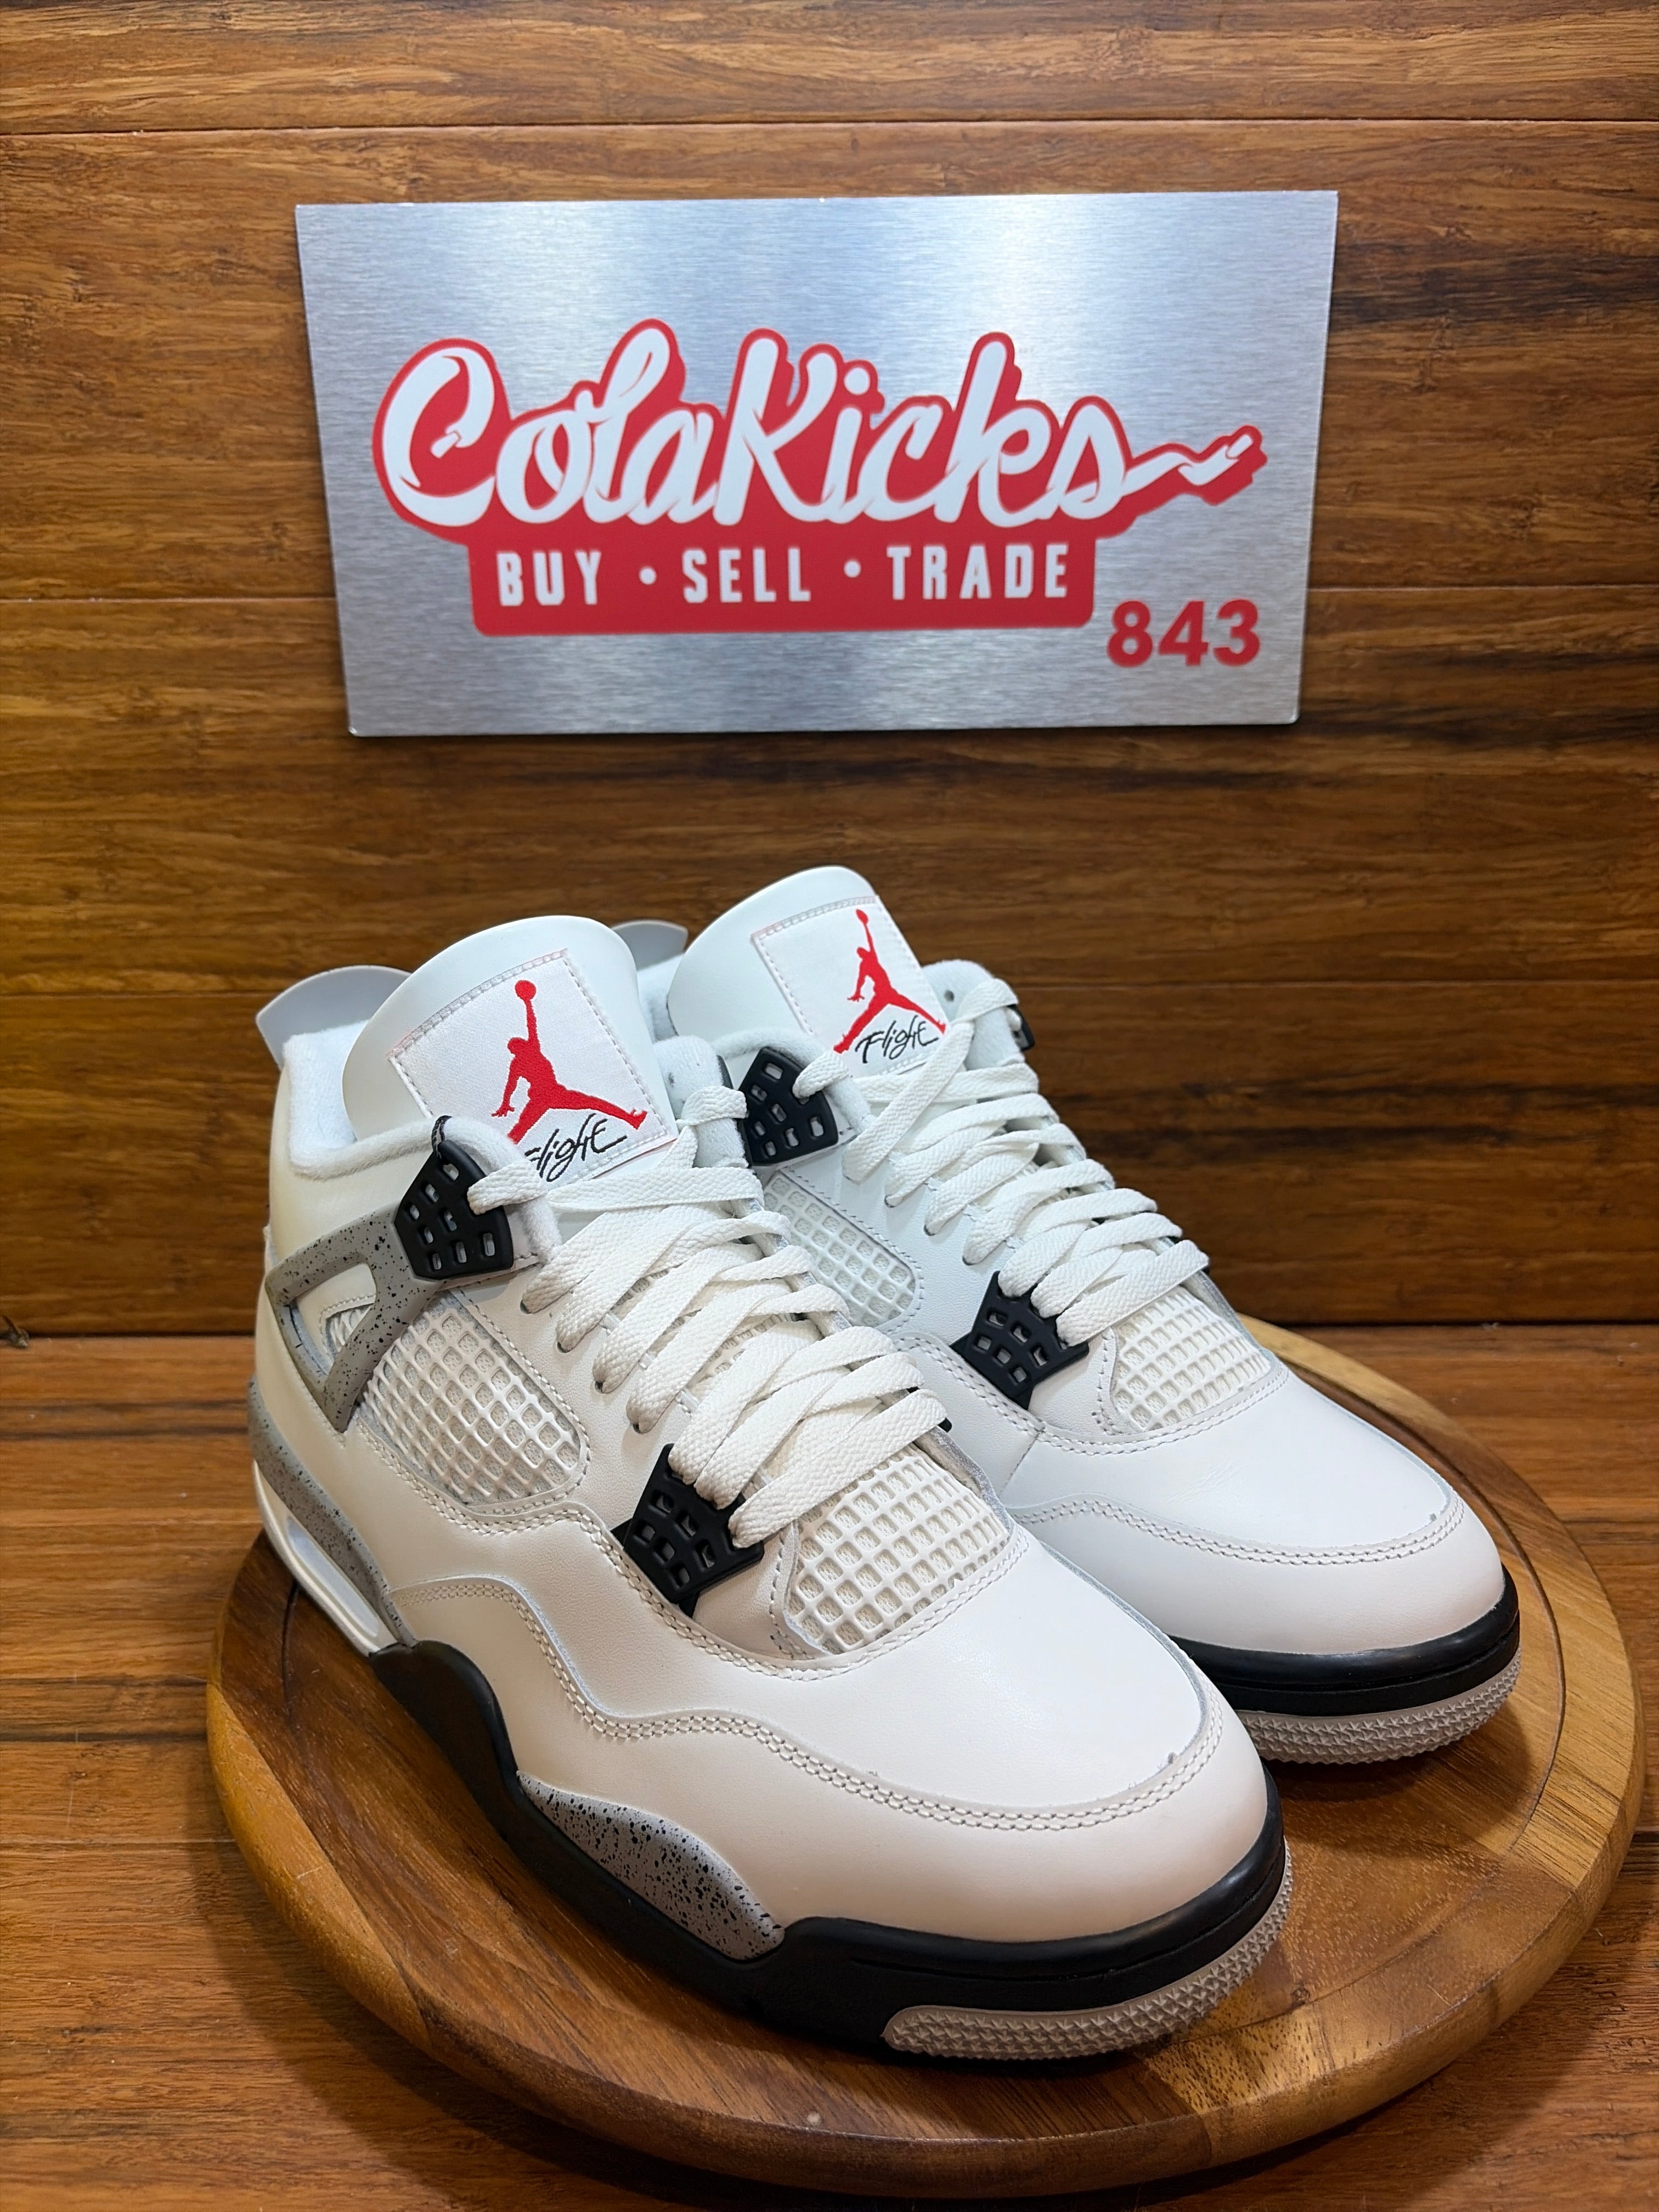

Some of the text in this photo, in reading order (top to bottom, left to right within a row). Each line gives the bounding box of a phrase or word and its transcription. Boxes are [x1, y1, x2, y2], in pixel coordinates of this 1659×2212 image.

[382, 326, 1253, 527] ColaKicks
[496, 544, 1069, 606] BUY SELL TRADE
[1107, 599, 1261, 668] 843
[855, 1014, 939, 1064] Flight
